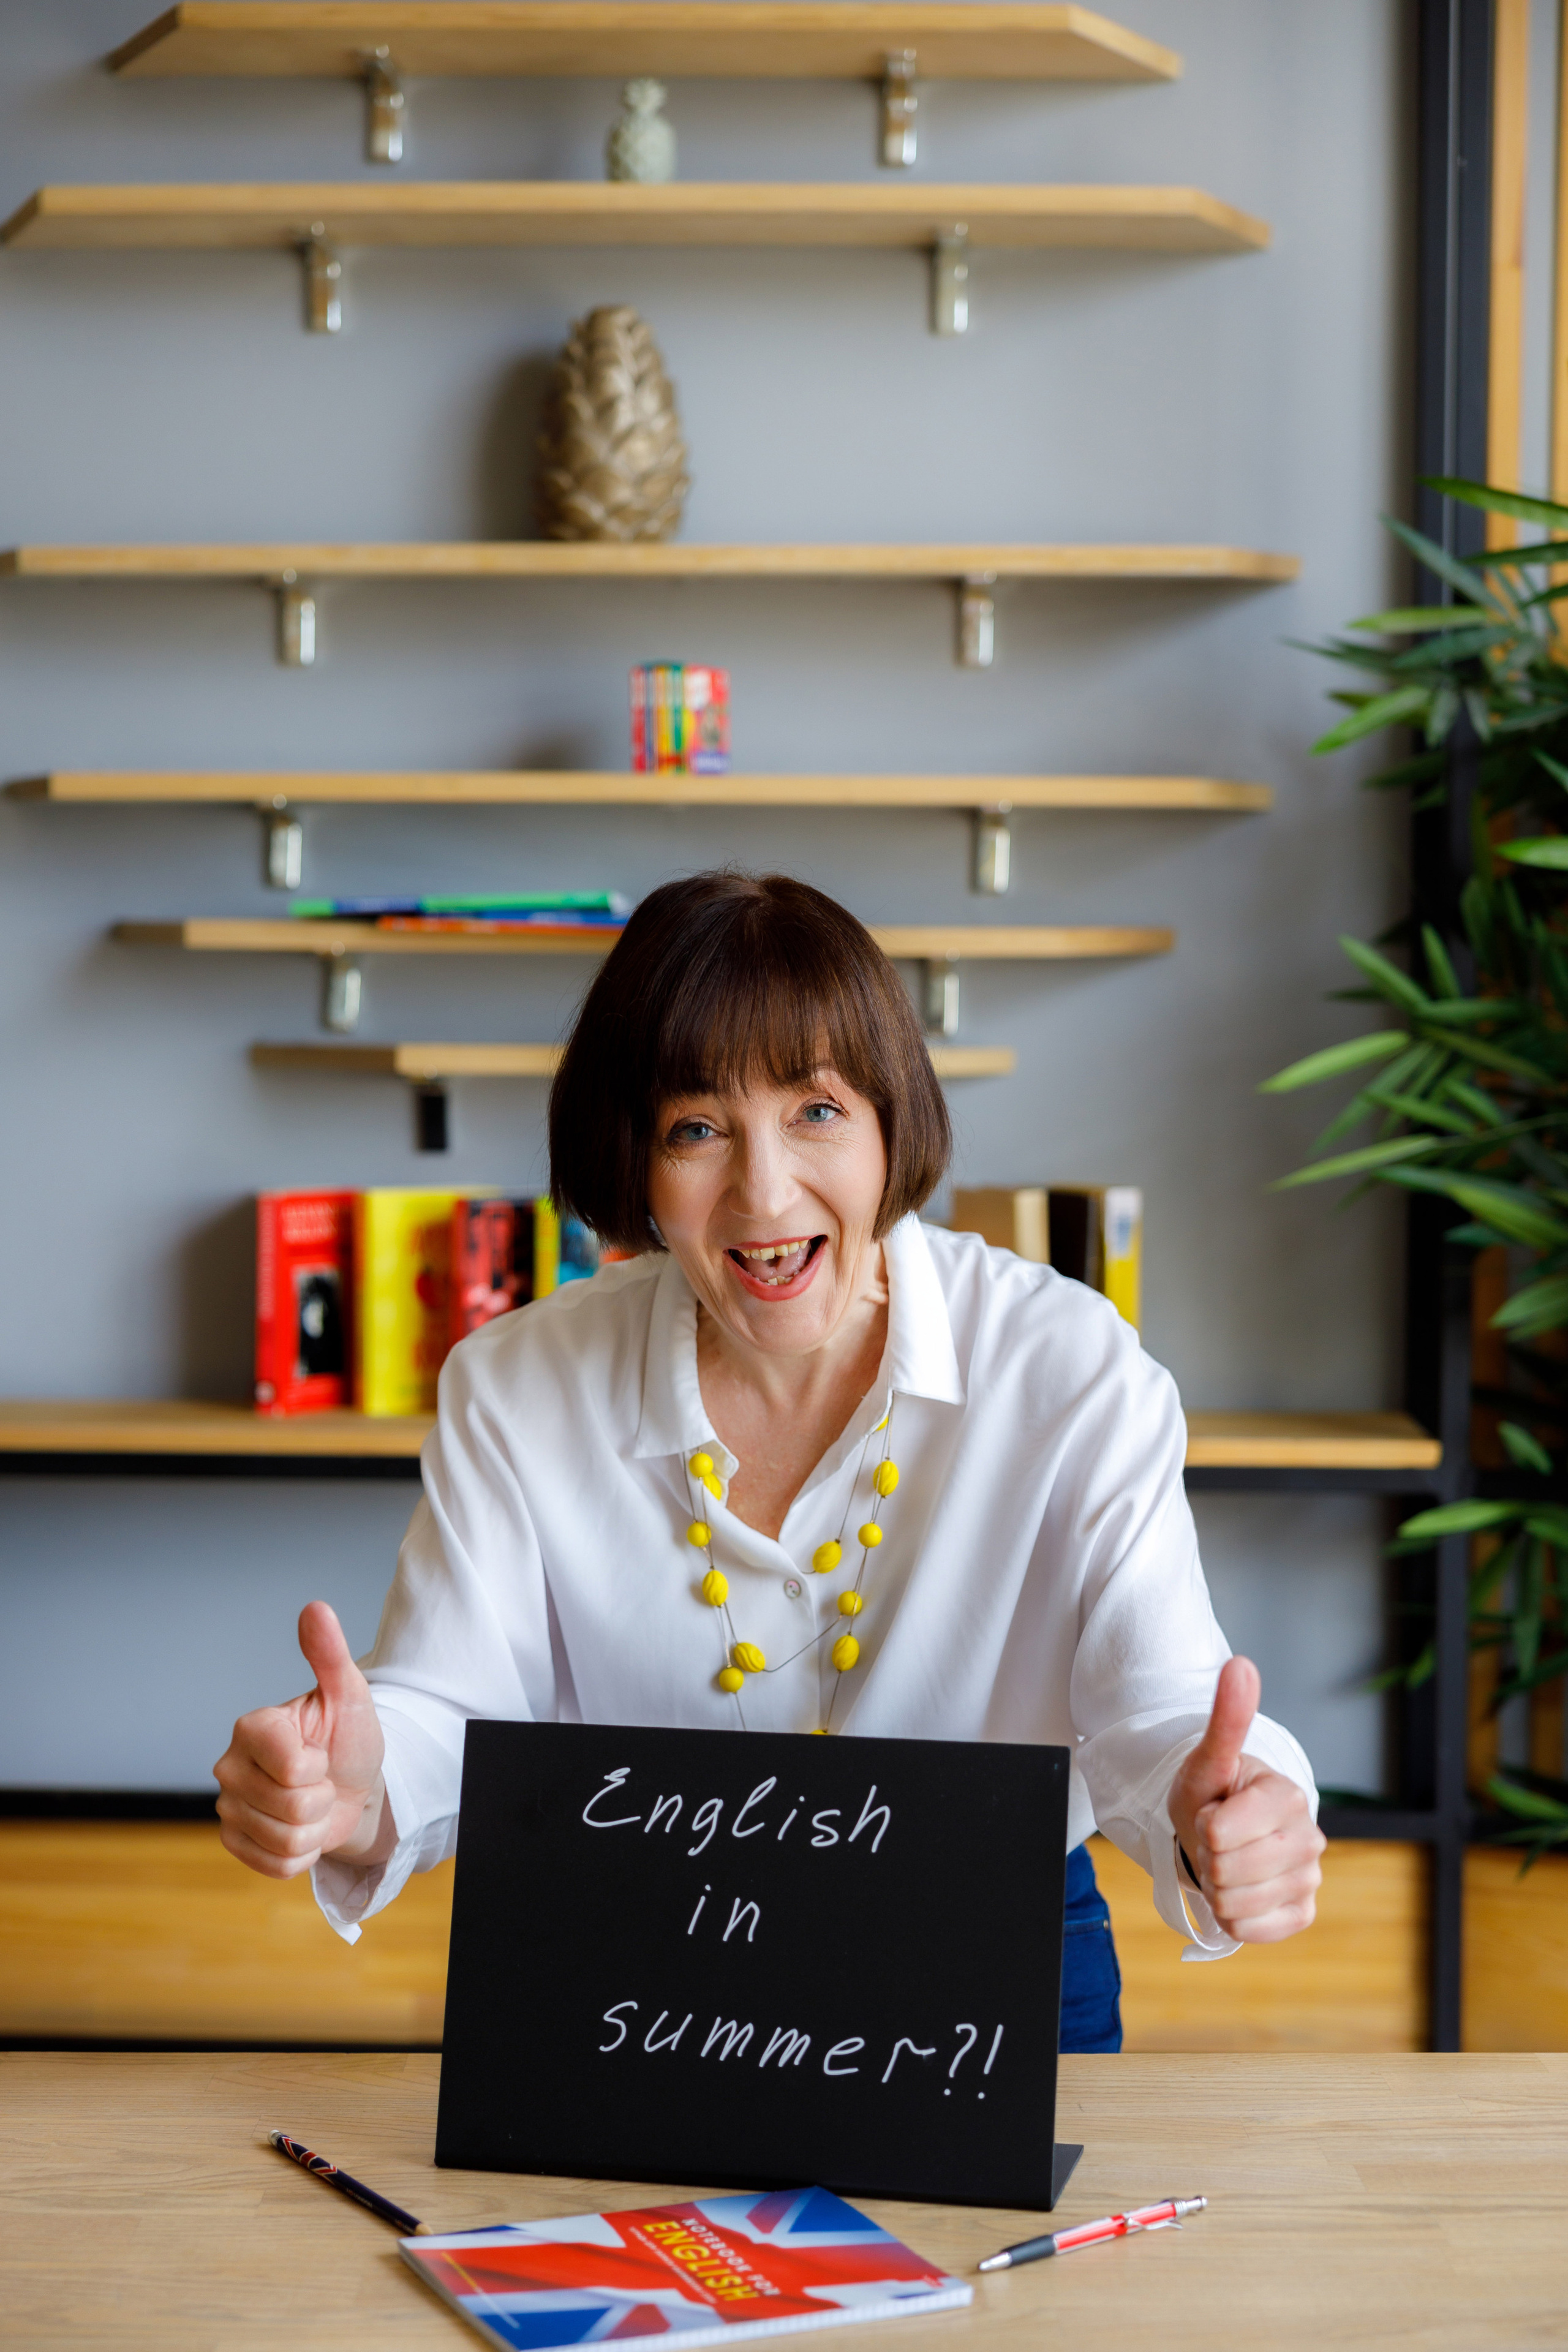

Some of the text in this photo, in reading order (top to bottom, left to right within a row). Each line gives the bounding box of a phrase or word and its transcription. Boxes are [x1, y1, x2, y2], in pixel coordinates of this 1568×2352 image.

[582, 1768, 890, 1856] English
[688, 1885, 760, 1942] in
[600, 2001, 1003, 2098] summer?!
[643, 2221, 760, 2301] ENGLISH
[682, 2218, 753, 2272] NOTEBOOK
[746, 2274, 781, 2296] FOR
